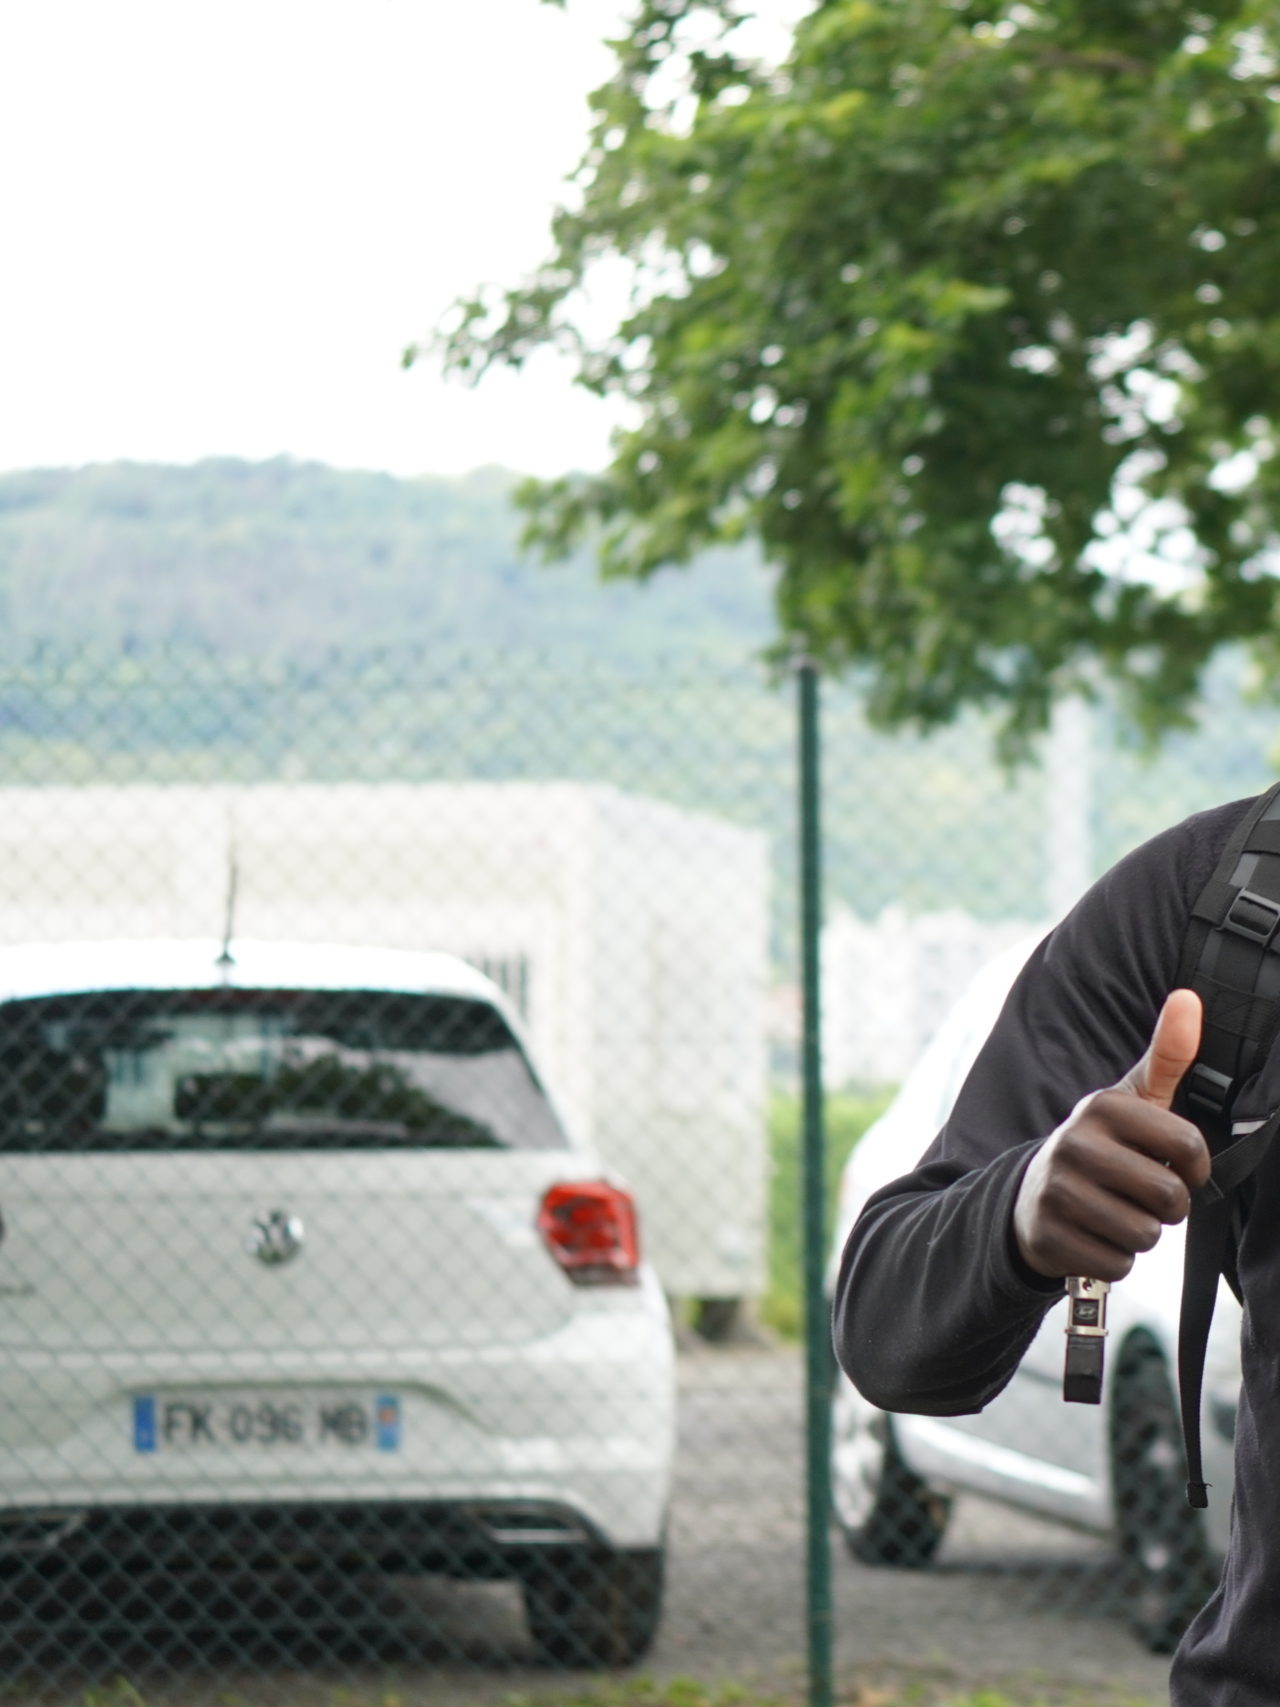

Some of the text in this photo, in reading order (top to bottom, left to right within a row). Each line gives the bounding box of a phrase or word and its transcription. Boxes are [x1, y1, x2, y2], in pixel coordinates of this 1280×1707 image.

[163, 1402, 368, 1446] FK 096 MB
